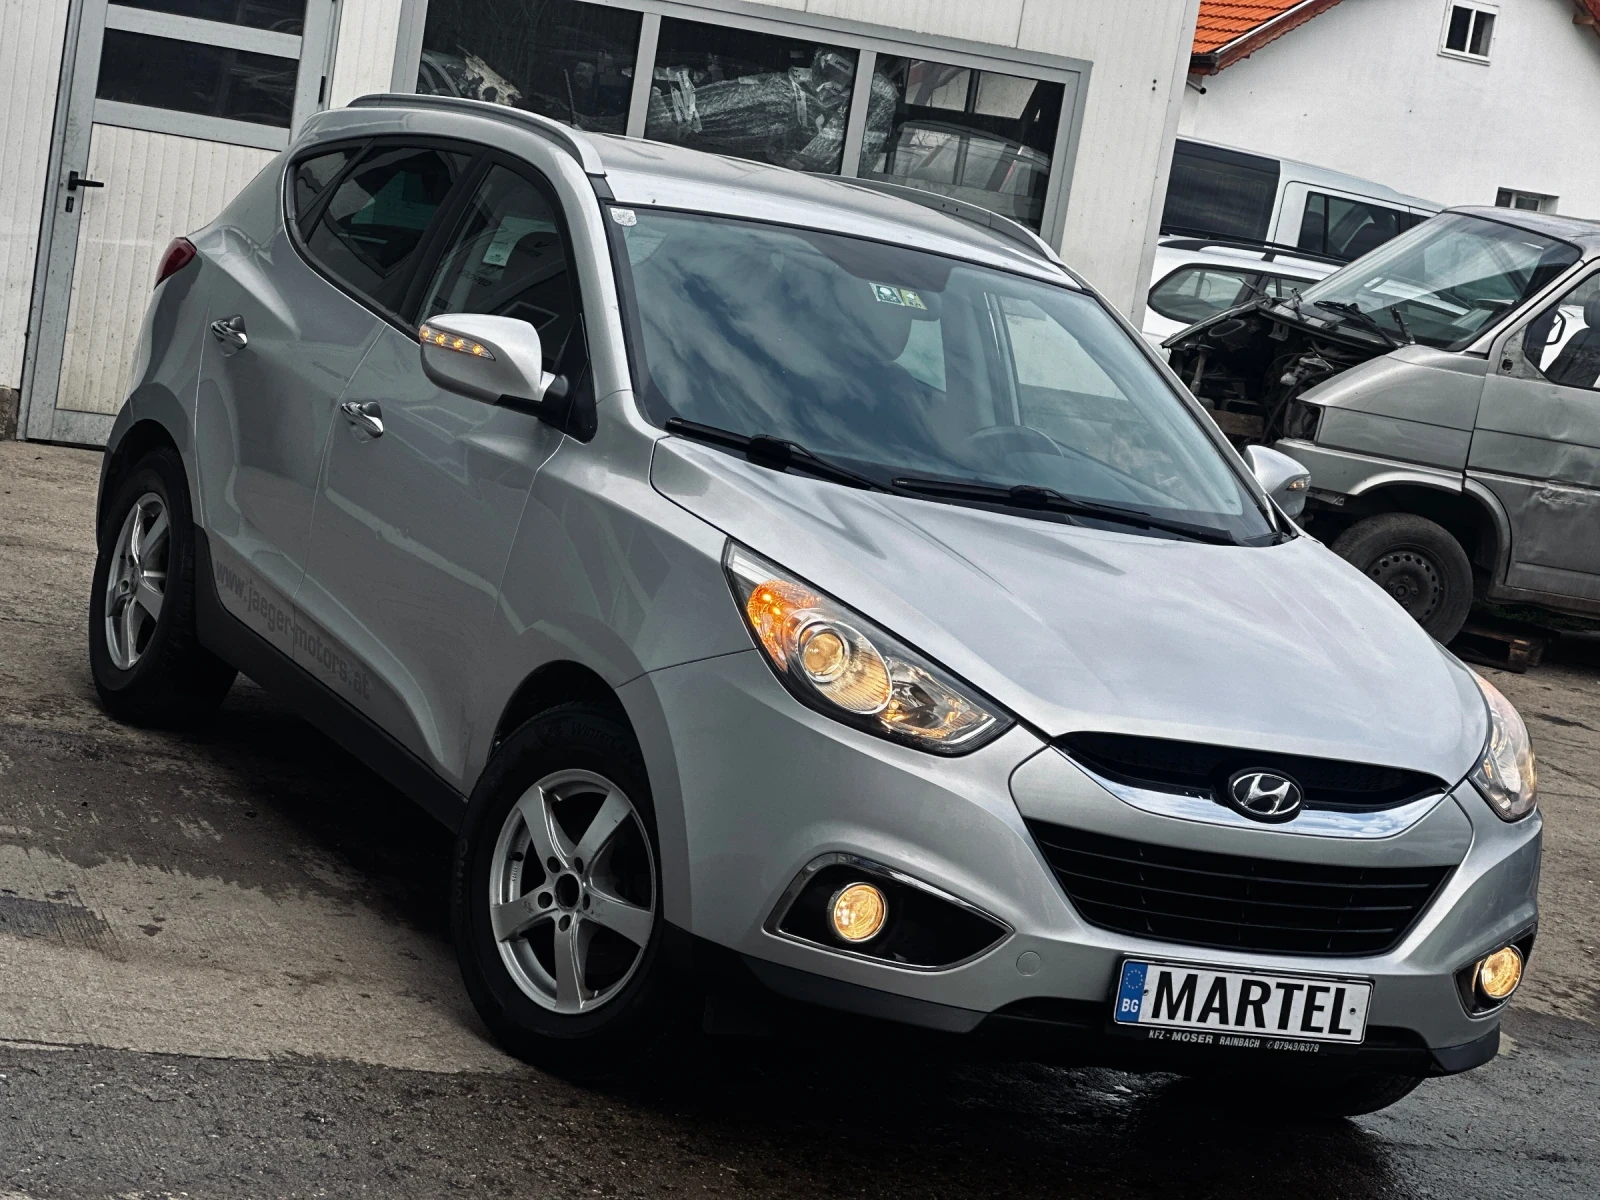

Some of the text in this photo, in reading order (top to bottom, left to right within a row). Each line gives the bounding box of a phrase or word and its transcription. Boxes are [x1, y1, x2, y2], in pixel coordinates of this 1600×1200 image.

[216, 560, 370, 701] www.jaeger-motors.at
[1121, 998, 1139, 1013] BG
[1151, 970, 1352, 1035] MARTEL
[1171, 1031, 1214, 1044] MOSER
[1219, 1036, 1261, 1048] RAINBACH
